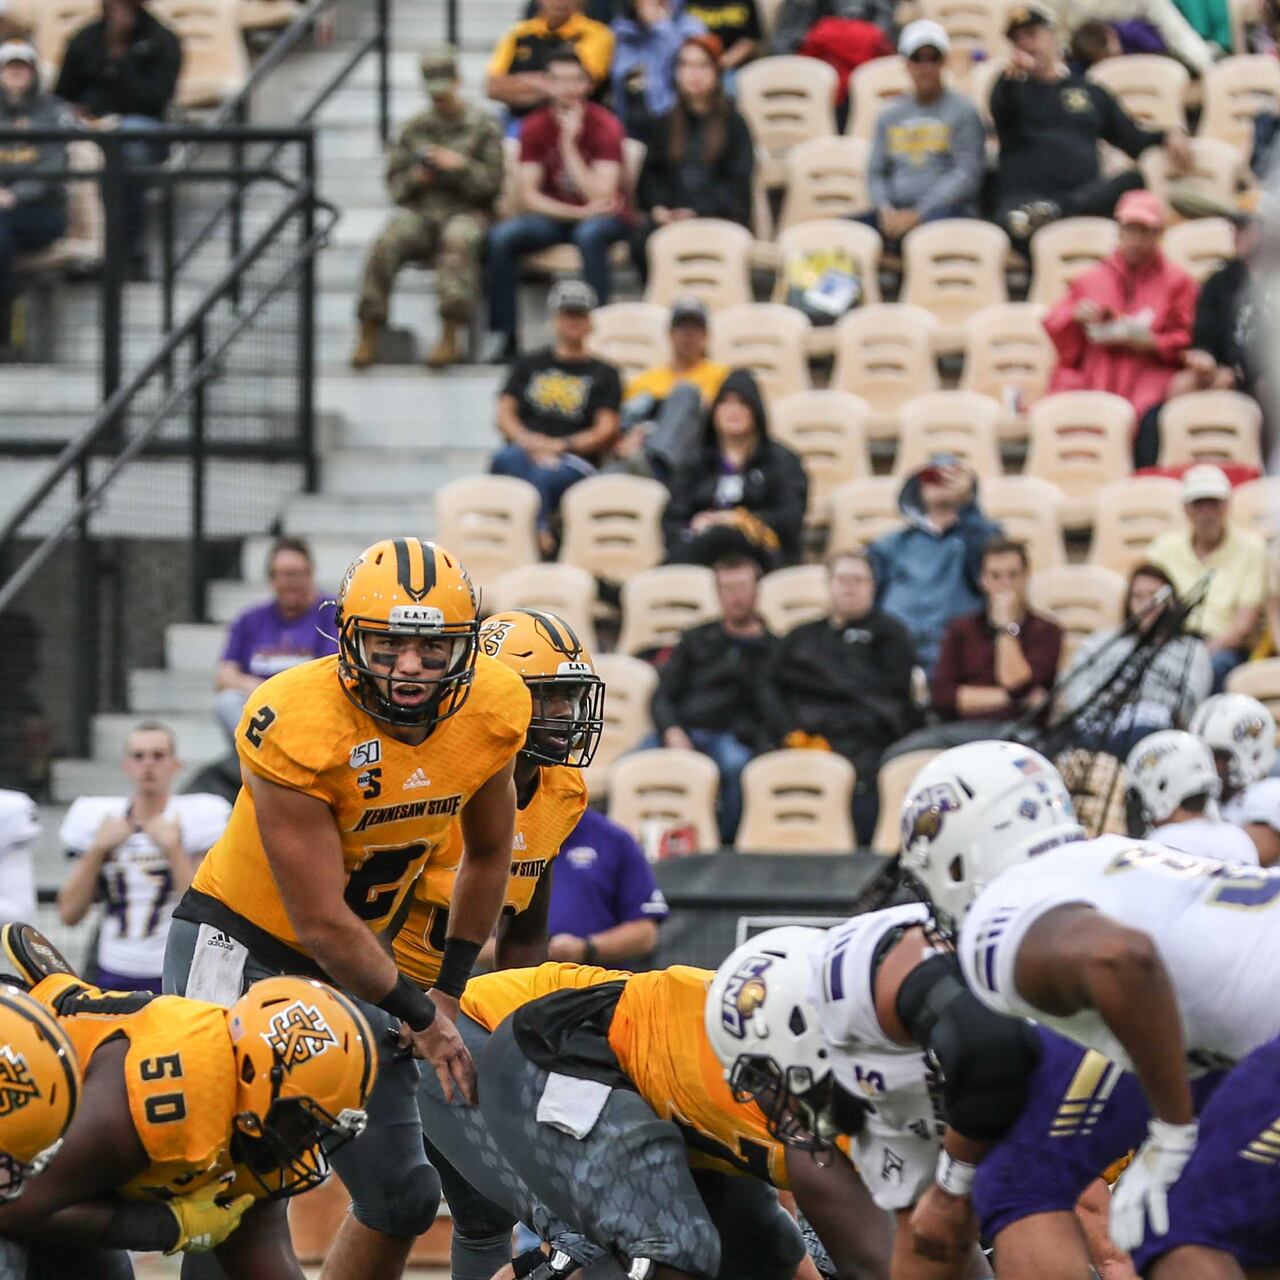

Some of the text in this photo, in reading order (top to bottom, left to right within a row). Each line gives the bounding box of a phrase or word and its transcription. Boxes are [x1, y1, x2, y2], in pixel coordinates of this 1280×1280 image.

[403, 610, 431, 620] E.A.T.
[245, 704, 276, 749] 2
[351, 795, 463, 832] KENNESAW STATE
[207, 938, 234, 952] adidas
[140, 1053, 187, 1124] 50
